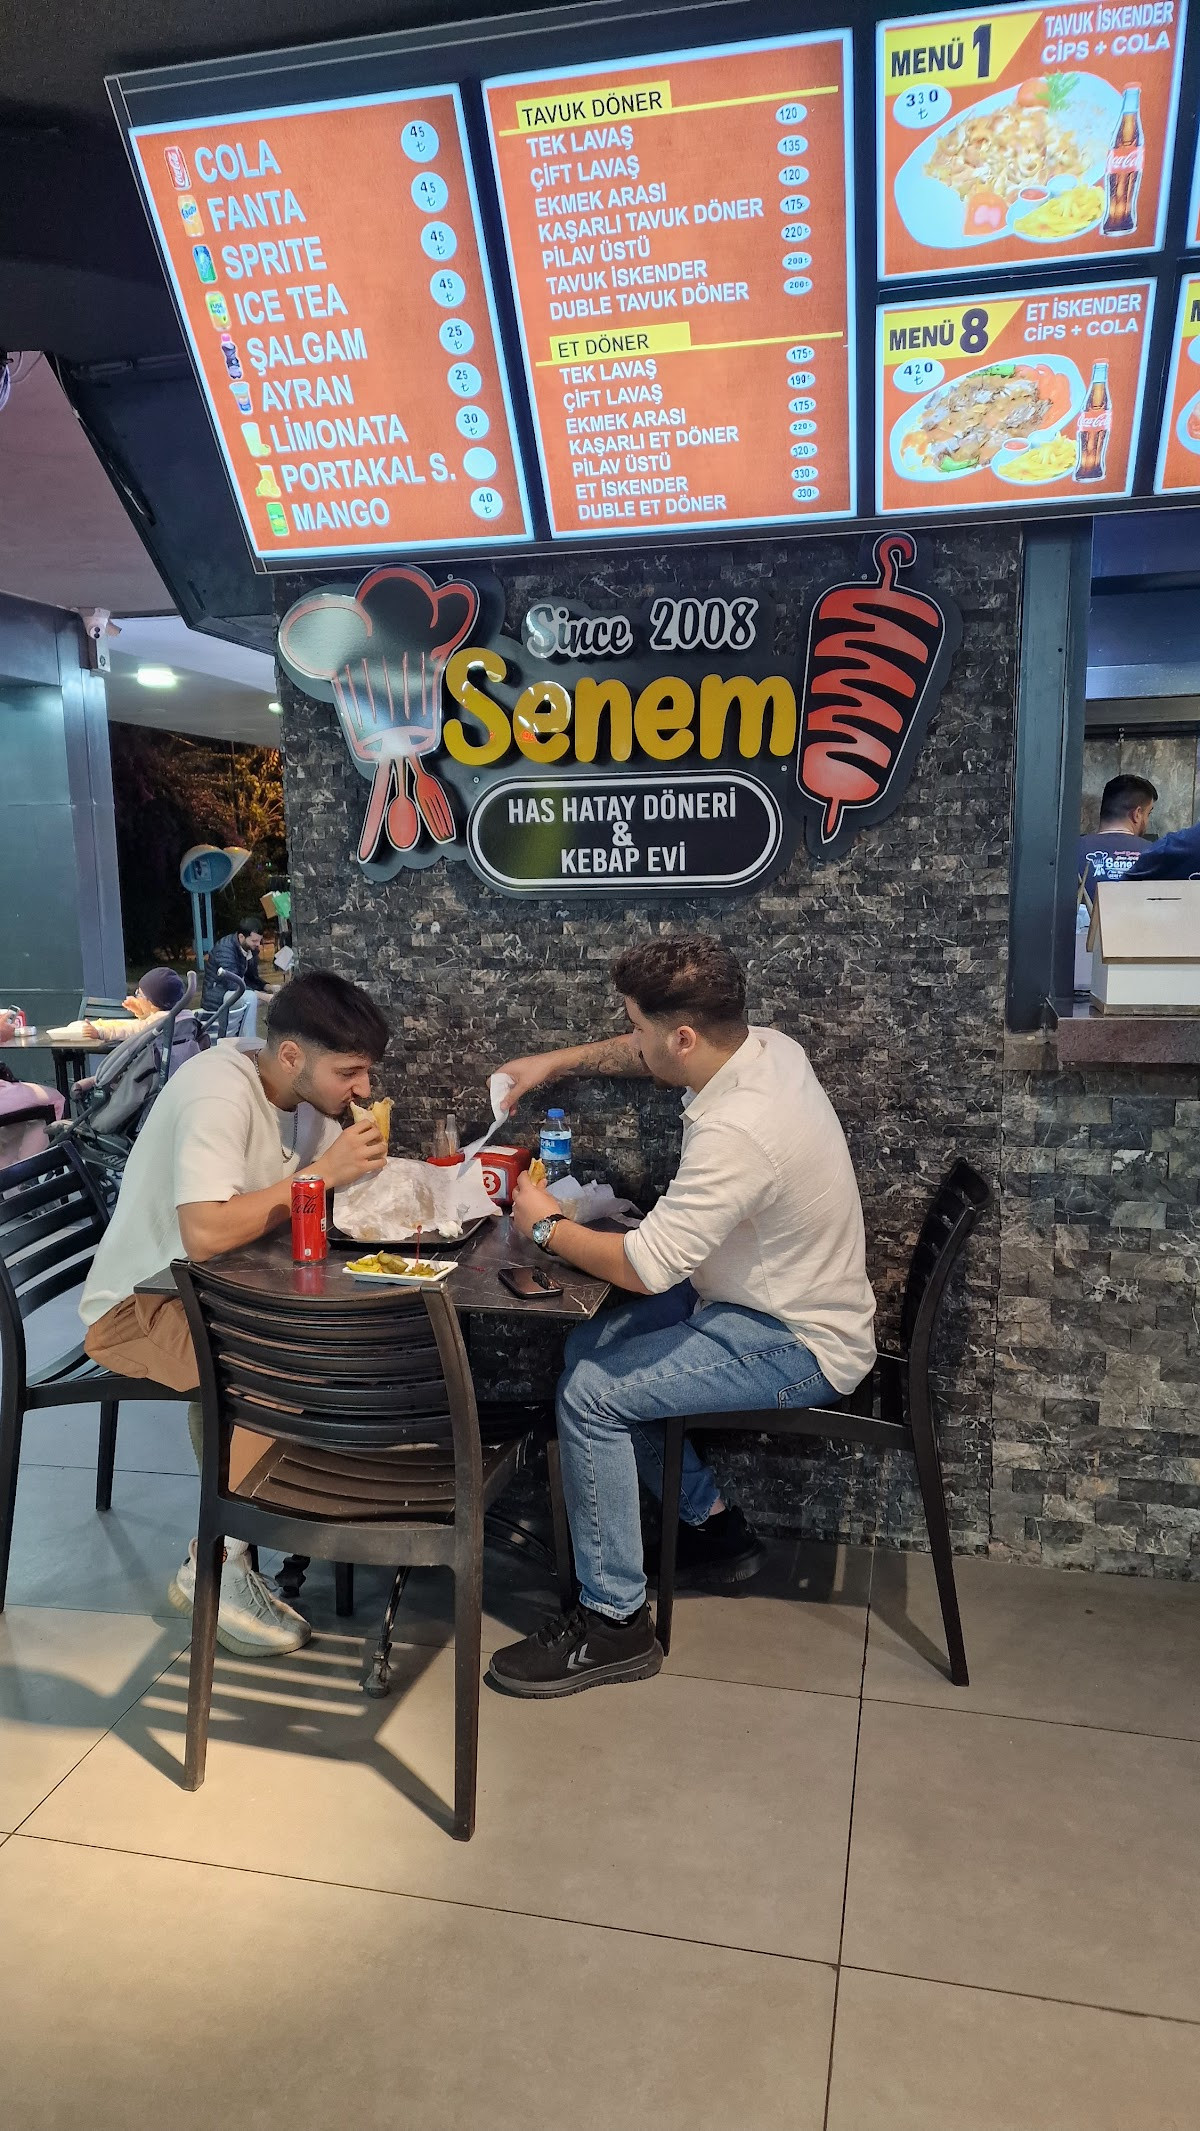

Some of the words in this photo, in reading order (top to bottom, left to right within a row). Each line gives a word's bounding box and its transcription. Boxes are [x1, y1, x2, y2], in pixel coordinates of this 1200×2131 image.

[1045, 11, 1094, 38] TAVUK
[1096, 1, 1174, 33] İSKENDER
[892, 38, 963, 77] MENÜ
[973, 24, 991, 78] 1
[1042, 39, 1088, 64] CİPS
[1094, 41, 1106, 54] +
[1111, 31, 1170, 56] COLA
[522, 102, 586, 126] TAVUK
[592, 92, 662, 117] DÖNER
[906, 90, 938, 106] 330
[411, 126, 424, 137] 45
[526, 134, 566, 157] TEK
[571, 126, 633, 152] LAVAŞ
[195, 140, 281, 183] COLA
[530, 163, 572, 192] ÇİFT
[578, 155, 640, 182] LAVAŞ
[421, 182, 435, 192] 45
[535, 190, 604, 217] EKMEK
[608, 182, 666, 208] ARASI
[208, 189, 306, 232] FANTA
[538, 214, 621, 243] KAŞARLI
[626, 206, 689, 231] TAVUK
[694, 198, 764, 224] DÖNER
[431, 231, 444, 241] 45
[542, 245, 594, 269] PİLAV
[600, 235, 650, 262] ÜSTÜ
[222, 236, 327, 279] SPRITE
[440, 278, 452, 288] 45
[546, 271, 608, 294] TAVUK
[612, 260, 707, 287] İSKENDER
[234, 290, 285, 325] ICE
[286, 284, 348, 320] TEA
[550, 296, 612, 320] DUBLE
[616, 289, 677, 312] TAVUK
[682, 282, 749, 305] DÖNER
[1026, 303, 1049, 321] ET
[1052, 294, 1141, 319] İSKENDER
[447, 326, 462, 337] 25
[558, 342, 579, 357] ET
[586, 334, 649, 354] DÖNER
[890, 320, 954, 351] MENÜ
[960, 308, 988, 353] 8
[1024, 323, 1066, 342] CİPS
[1072, 325, 1081, 336] +
[1086, 318, 1138, 336] COLA
[247, 328, 368, 376] ŞALGAM
[456, 370, 467, 380] 25
[560, 366, 596, 384] TEK
[600, 359, 657, 380] LAVAŞ
[904, 363, 932, 375] 420
[263, 375, 354, 412] AYRAN
[564, 389, 601, 413] ÇİFT
[607, 384, 662, 405] LAVAŞ
[270, 414, 408, 453] LİMONATA
[464, 414, 478, 423] 30
[566, 413, 628, 434] EKMEK
[632, 408, 685, 428] ARASI
[570, 434, 644, 456] KAŞARLI
[650, 432, 670, 448] ET
[676, 426, 739, 447] DÖNER
[281, 456, 426, 493] PORTAKAL
[430, 453, 456, 482] S.
[573, 458, 620, 477] PİLAV
[626, 452, 670, 472] ÜSTÜ
[479, 493, 492, 502] 40
[576, 483, 596, 500] ET
[601, 476, 688, 497] İSKENDER
[292, 498, 390, 531] MANGO
[578, 501, 635, 520] DUBLE
[640, 500, 660, 516] ET
[666, 494, 726, 514] DÖNER
[526, 603, 633, 658] Since
[649, 597, 759, 651] 2008
[443, 647, 797, 766] Senem
[508, 797, 554, 824] HAS
[562, 796, 636, 822] HATAY
[644, 787, 736, 819] DÖNERİ
[612, 821, 633, 847] &
[561, 847, 640, 874] KEBAP
[648, 841, 686, 872] EVİ
[1105, 857, 1135, 868] Sene
